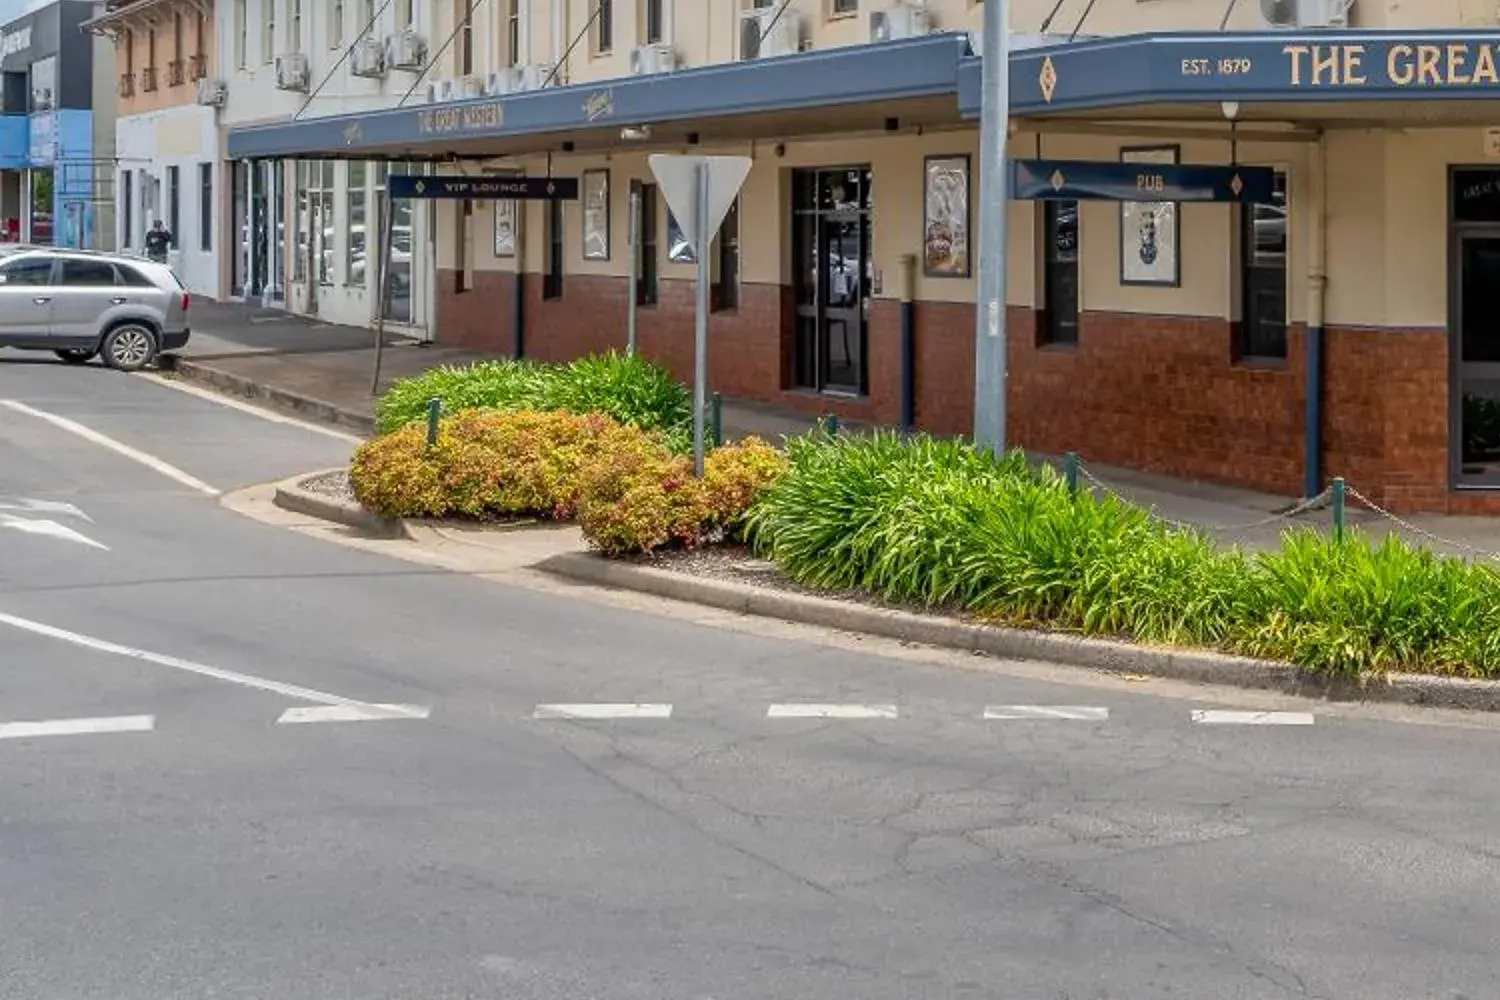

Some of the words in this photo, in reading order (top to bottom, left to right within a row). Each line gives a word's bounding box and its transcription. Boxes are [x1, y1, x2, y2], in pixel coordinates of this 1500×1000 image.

[1181, 59, 1212, 75] EST.
[1217, 58, 1251, 75] 1879
[1282, 44, 1367, 86] THE
[445, 183, 468, 192] VIP
[472, 183, 528, 193] LOUNGE
[1137, 174, 1164, 192] PUB
